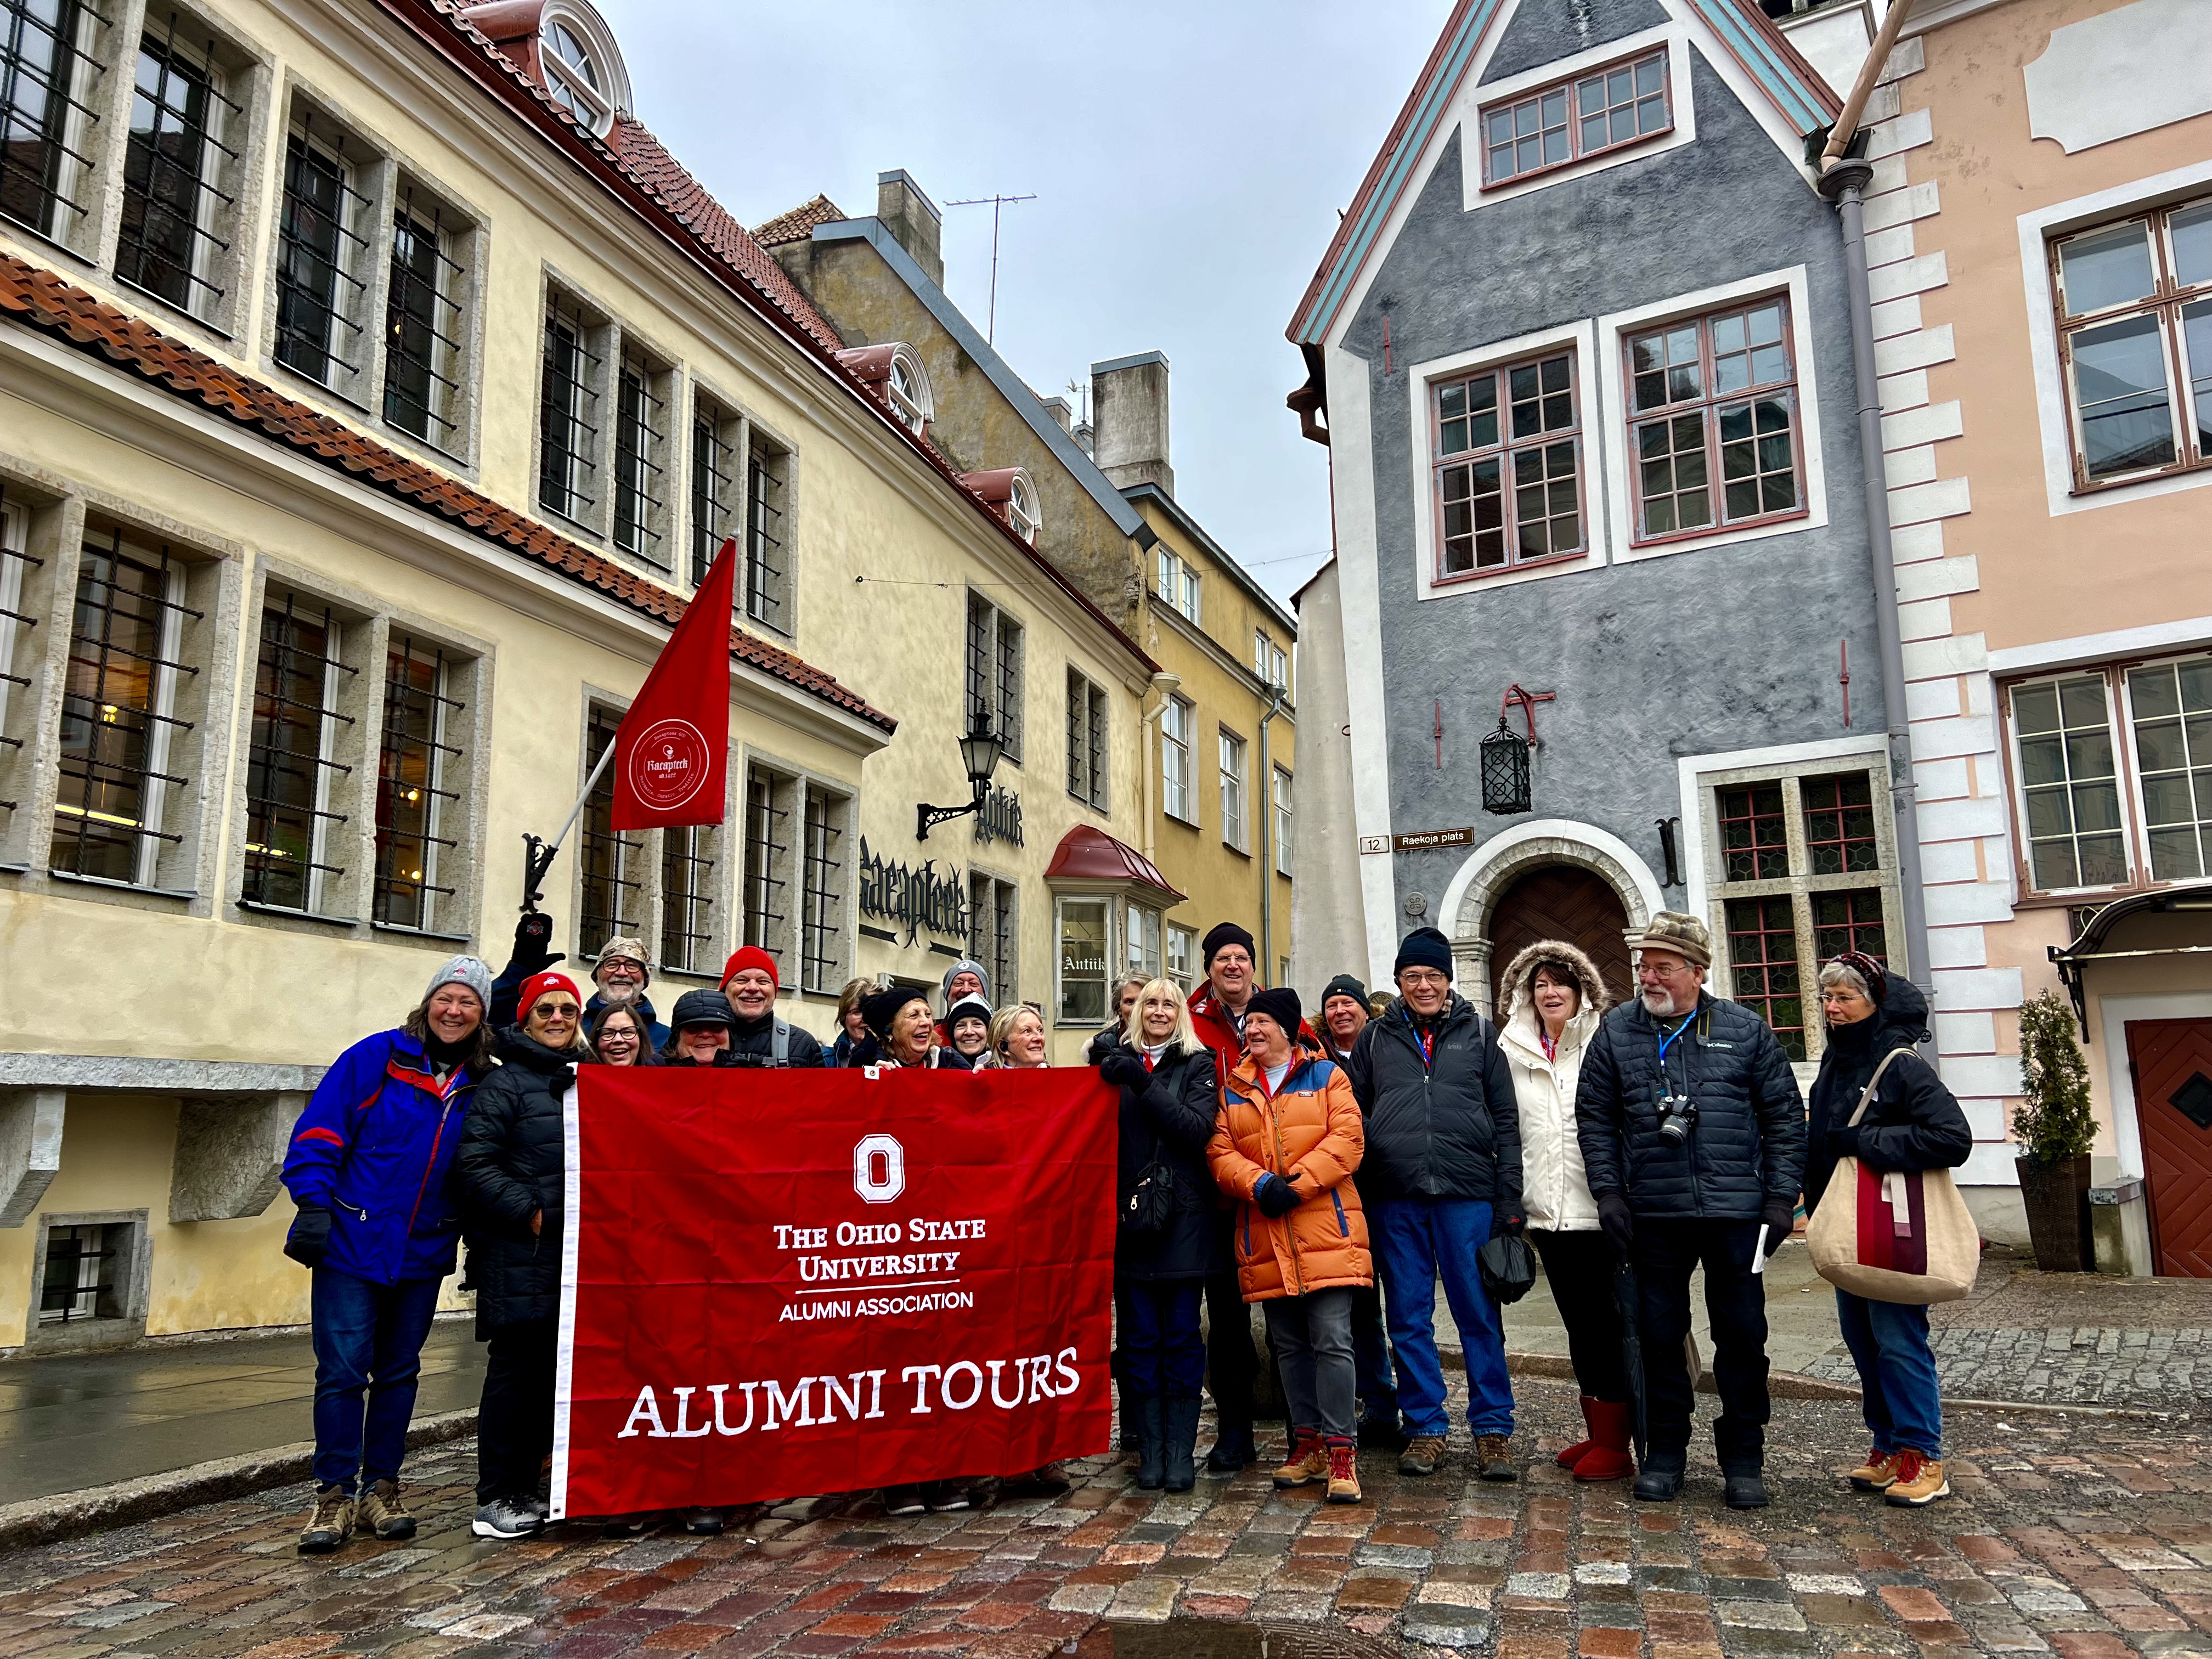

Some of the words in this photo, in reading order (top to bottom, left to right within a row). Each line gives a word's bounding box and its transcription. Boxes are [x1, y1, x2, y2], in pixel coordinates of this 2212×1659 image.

[647, 758, 689, 772] Raeapteek
[1367, 839, 1380, 851] 12
[1402, 834, 1438, 845] Raekoja
[1441, 832, 1464, 843] plats
[1063, 956, 1105, 970] Antiik
[773, 1224, 828, 1249] THE
[836, 1221, 901, 1246] OHIO
[909, 1218, 986, 1242] STATE
[797, 1251, 961, 1282] UNIVERSITY
[778, 1301, 851, 1322] ALUMNI
[854, 1291, 973, 1317] ASSOCIATION
[617, 1369, 887, 1438] ALUMNI
[901, 1346, 1080, 1414] TOURS
